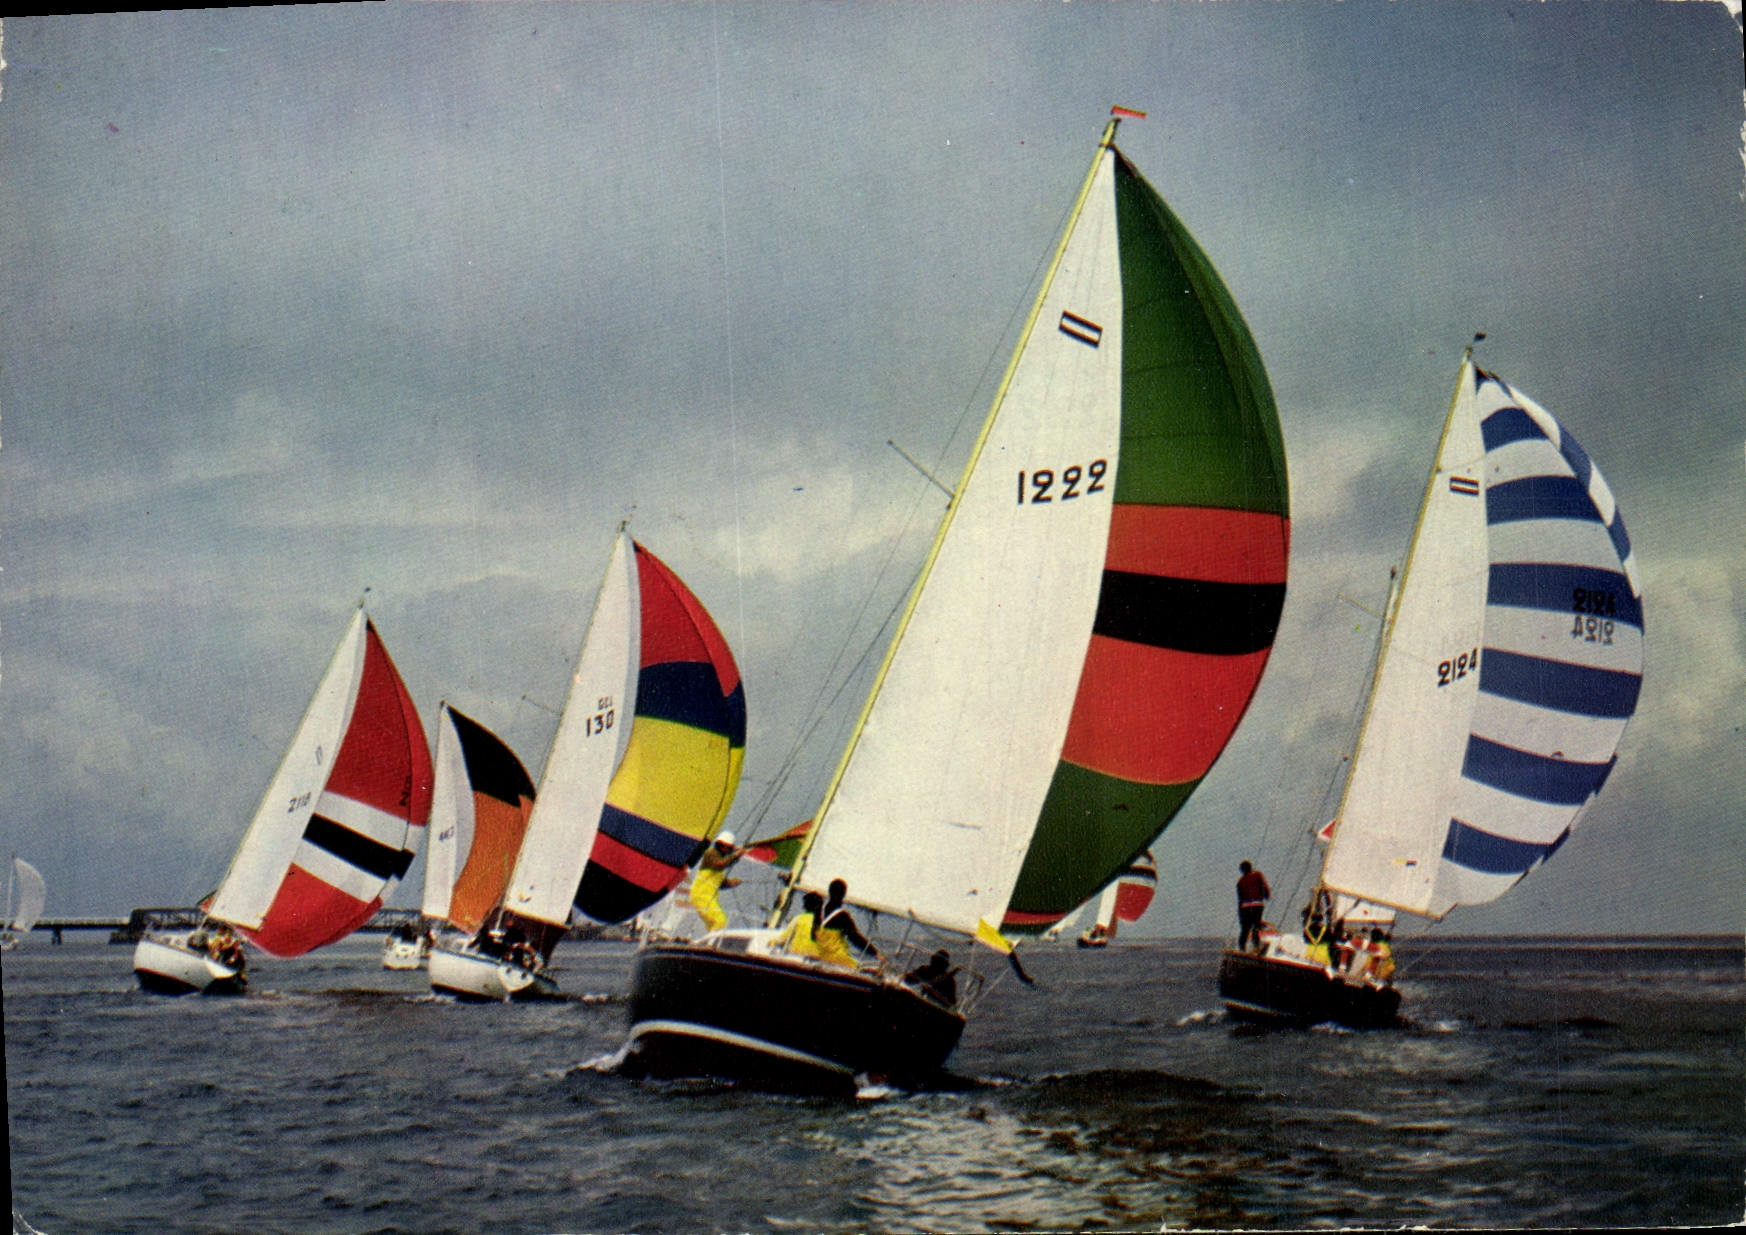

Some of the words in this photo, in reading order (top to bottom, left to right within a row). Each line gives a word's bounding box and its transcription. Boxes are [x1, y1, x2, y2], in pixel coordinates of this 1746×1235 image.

[1018, 459, 1107, 504] 1222
[1437, 646, 1478, 687] 2124
[586, 709, 615, 738] 130
